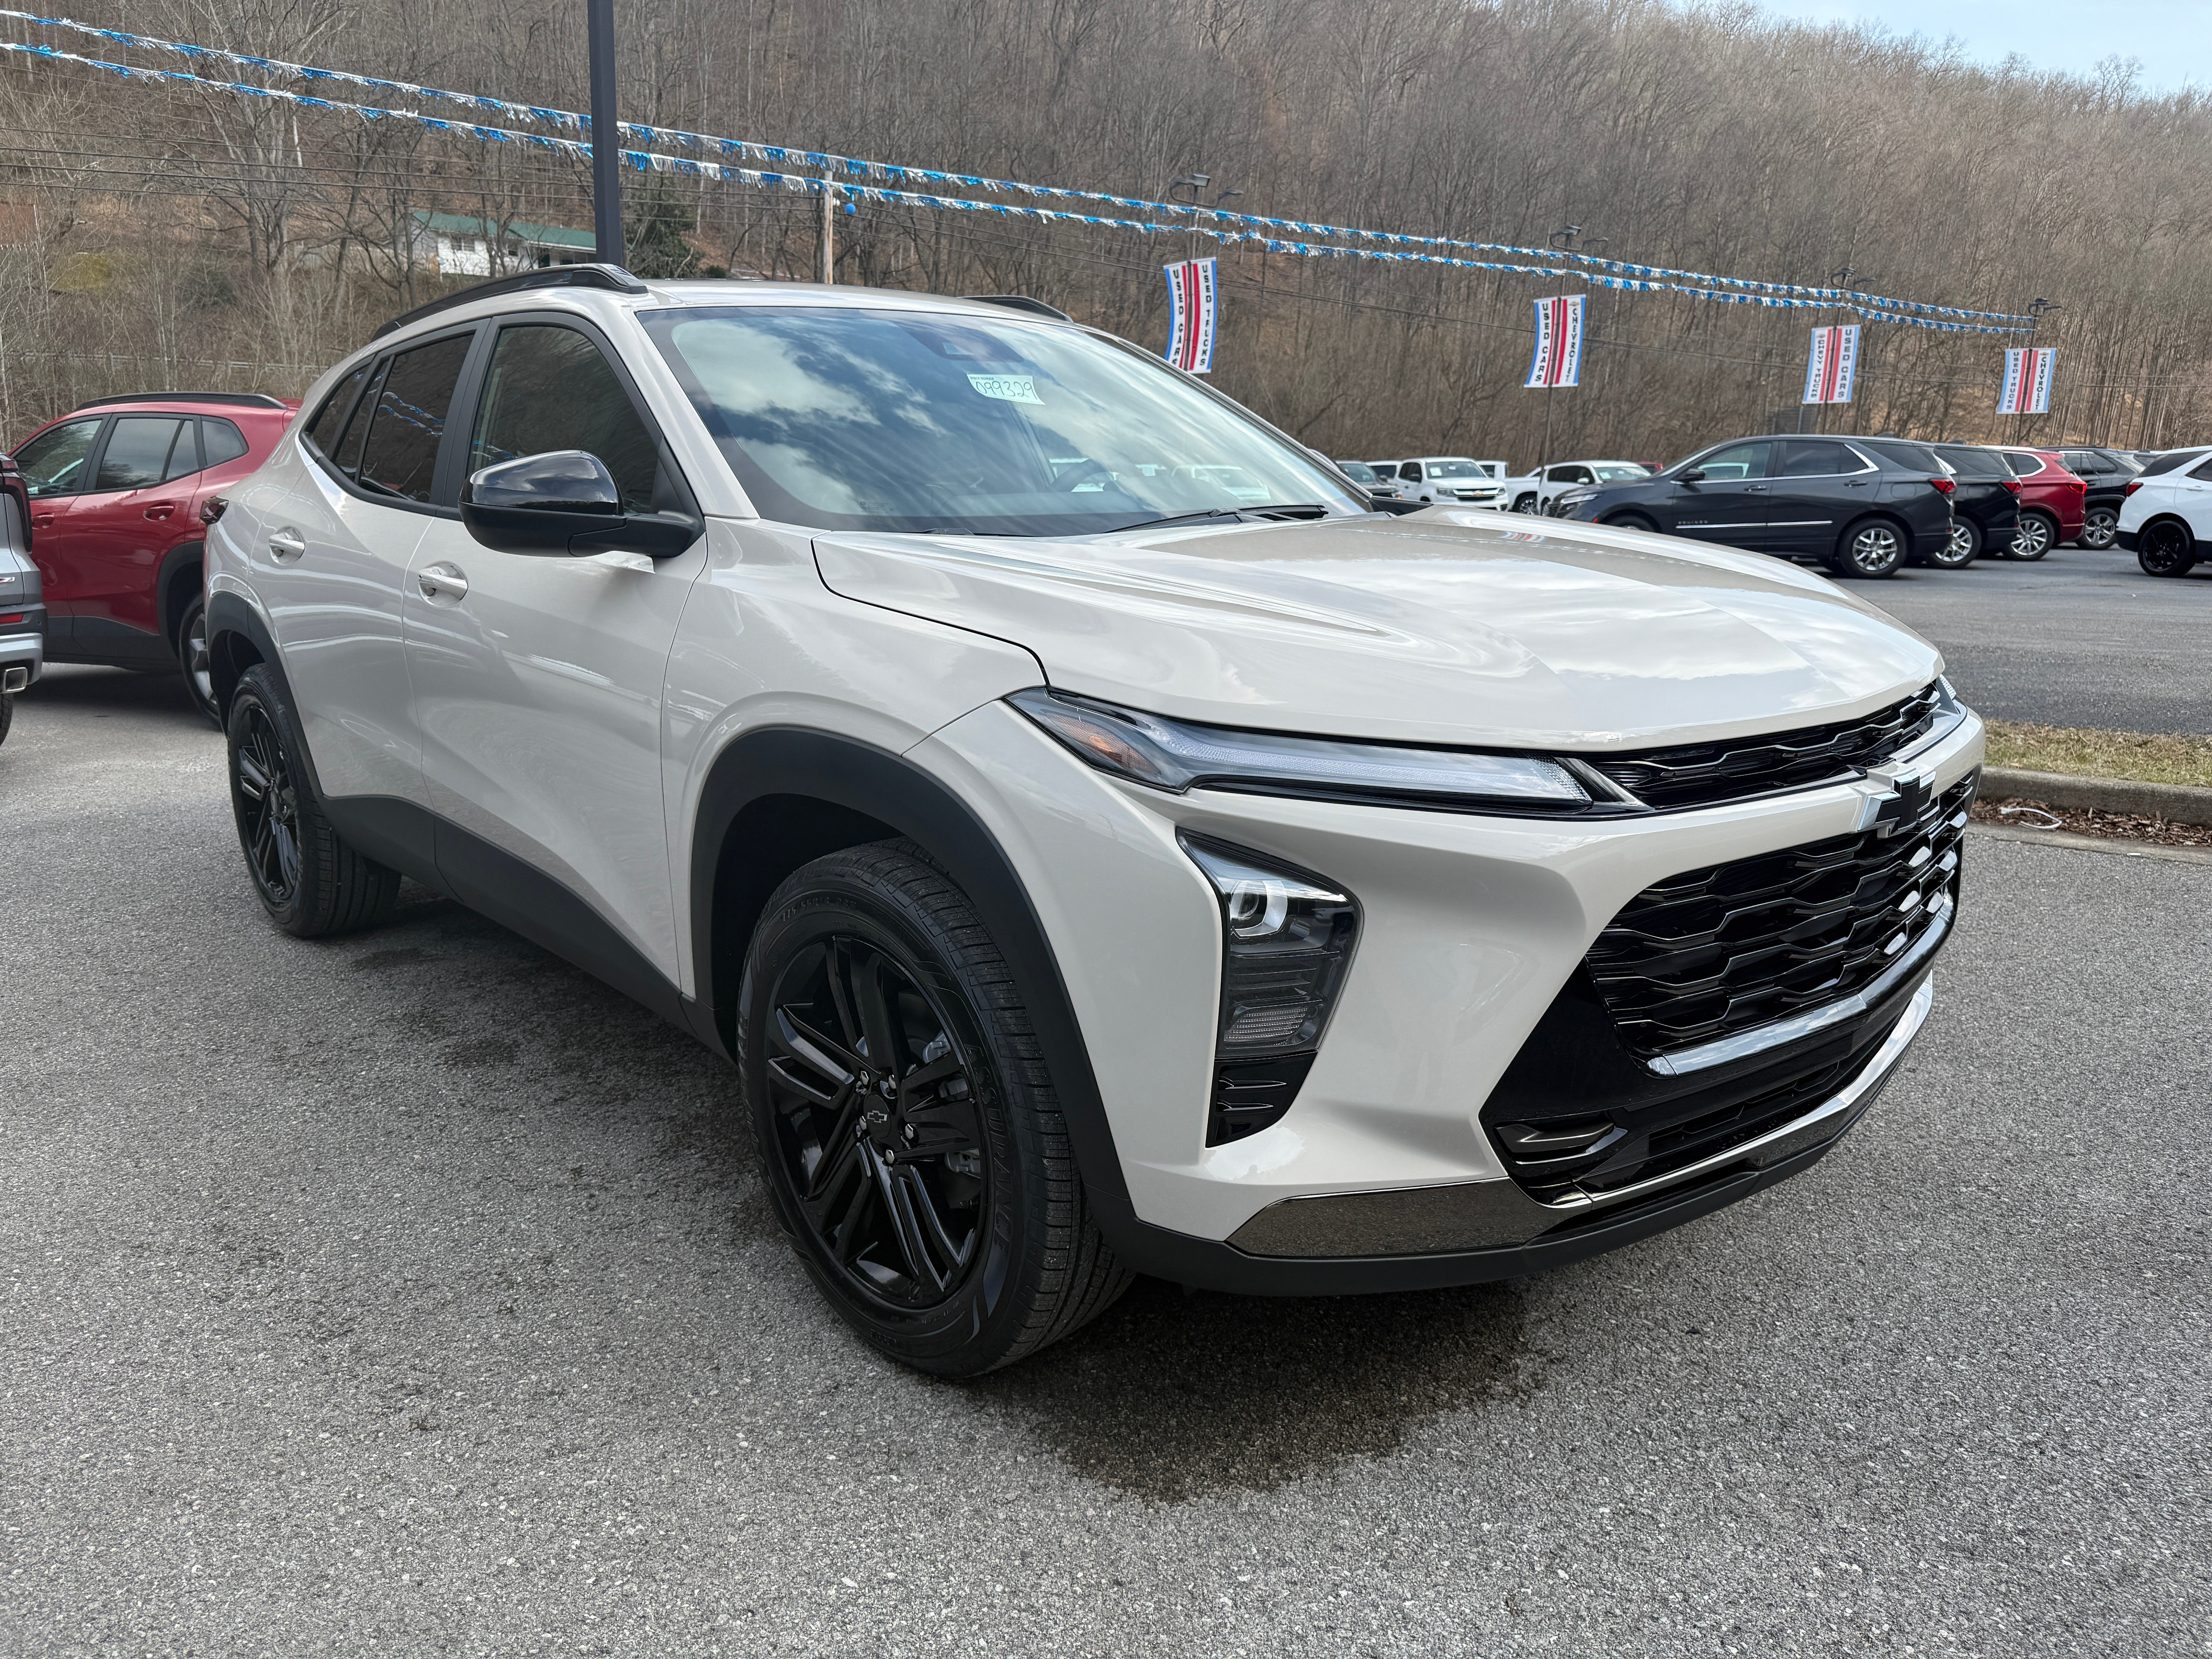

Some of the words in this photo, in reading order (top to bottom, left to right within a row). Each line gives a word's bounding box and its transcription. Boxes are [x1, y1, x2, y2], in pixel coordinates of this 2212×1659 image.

[1173, 270, 1183, 314] USED
[1202, 265, 1212, 303] USED
[1200, 309, 1211, 366] TRUCKS
[1842, 330, 1852, 361] USED
[1535, 347, 1548, 381] CARS
[975, 381, 1037, 400] 099329
[1838, 367, 1848, 398] CARS
[2006, 376, 2017, 410] TRUCKS
[2035, 357, 2047, 410] CHEVROLET
[964, 1042, 1013, 1254] ASSURANCE
